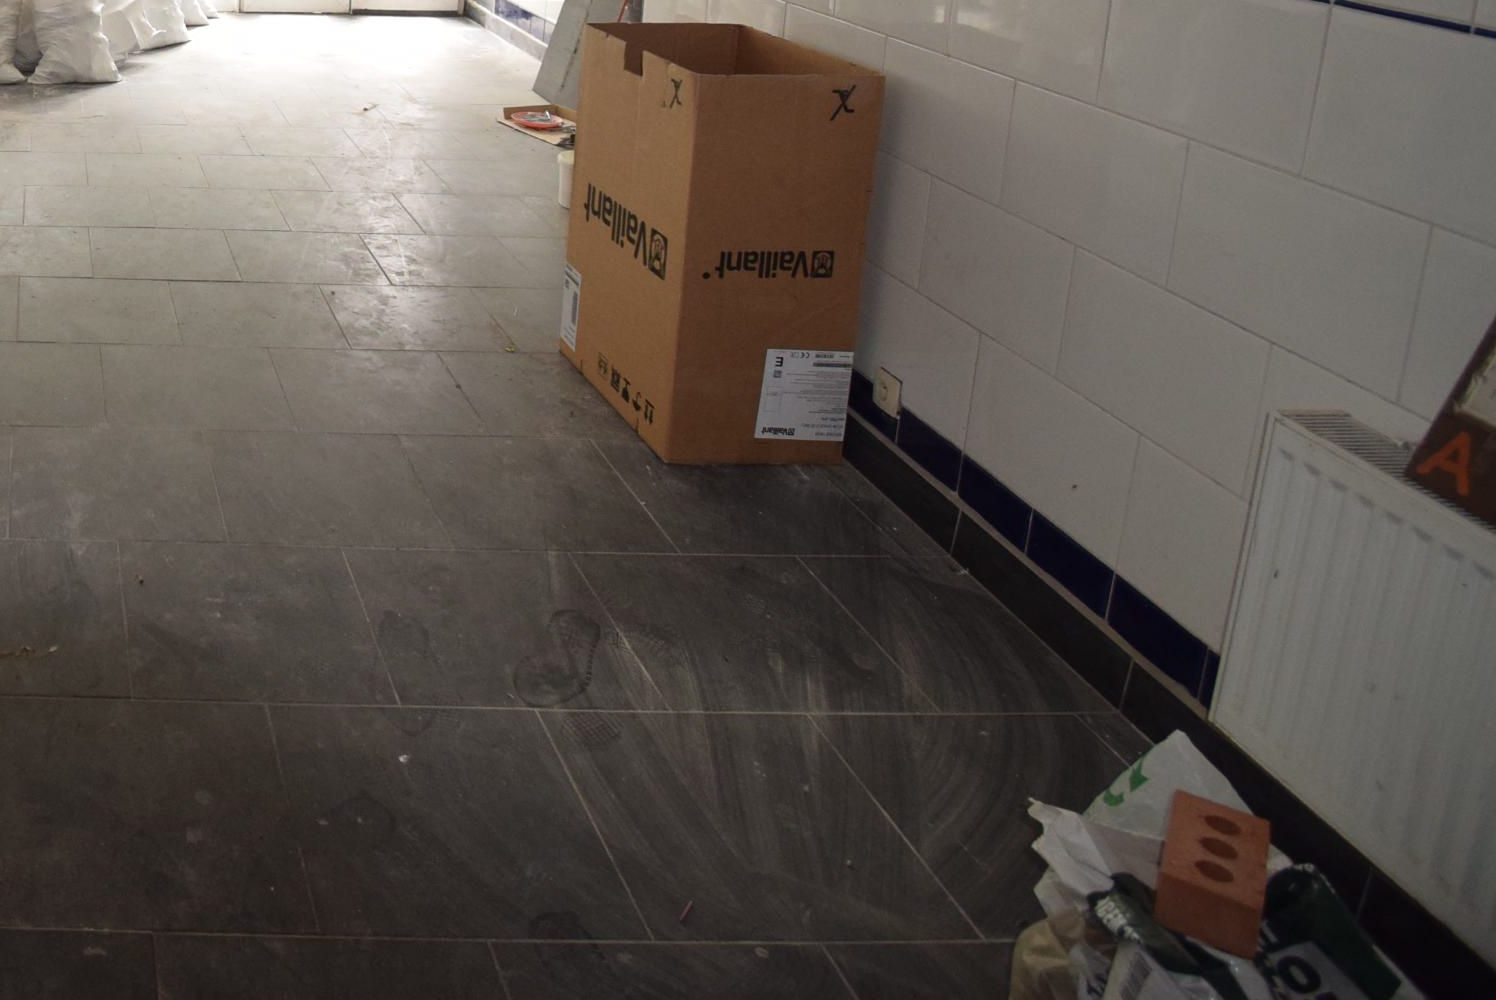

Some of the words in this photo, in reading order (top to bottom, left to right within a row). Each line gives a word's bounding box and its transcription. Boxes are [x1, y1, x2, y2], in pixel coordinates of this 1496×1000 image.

[584, 183, 647, 267] Vaillant
[714, 251, 809, 279] Vaillant
[761, 426, 788, 436] Vaillant
[1415, 431, 1471, 497] A
